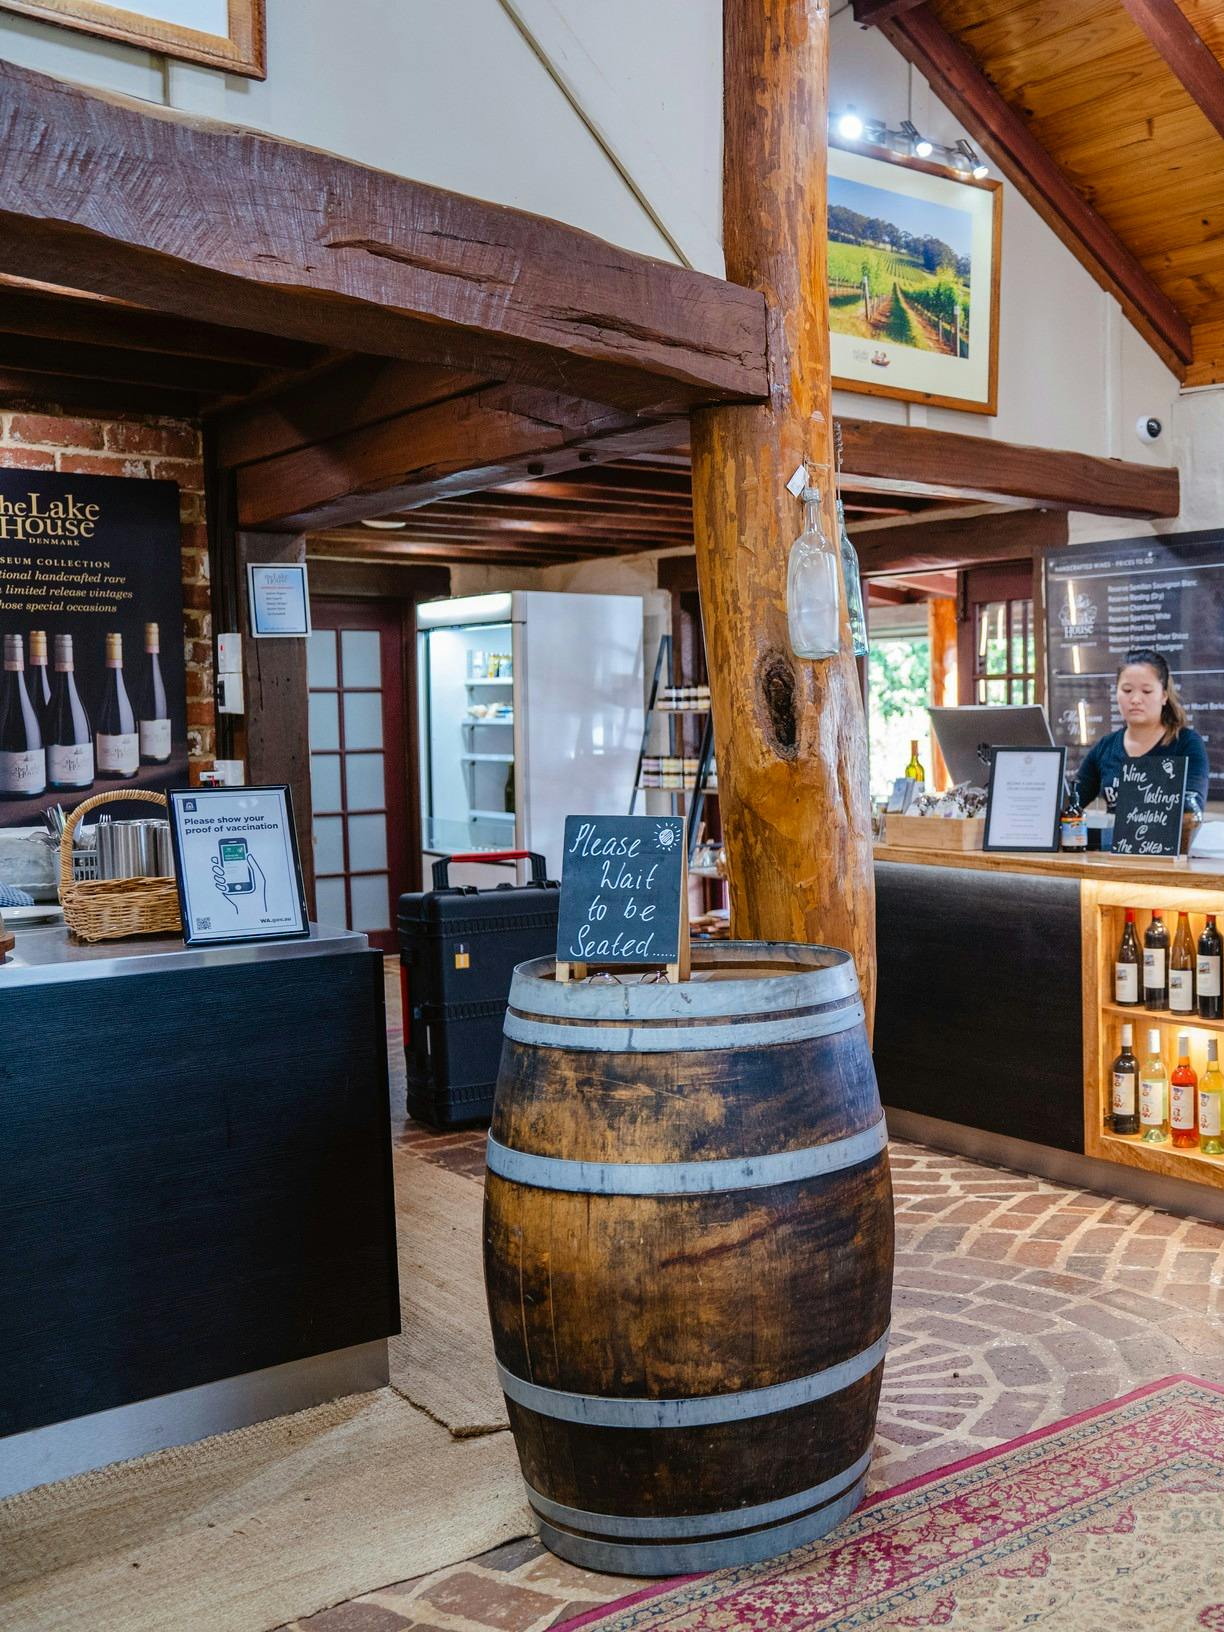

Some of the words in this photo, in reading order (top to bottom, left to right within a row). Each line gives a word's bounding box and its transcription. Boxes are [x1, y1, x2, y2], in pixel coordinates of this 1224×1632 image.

[0, 494, 27, 516] he
[27, 492, 100, 520] Lake
[0, 516, 95, 538] House
[28, 537, 80, 546] DENMARK
[0, 556, 31, 565] SEUM
[37, 558, 111, 569] COLLECTION
[0, 569, 32, 580] tional
[34, 571, 101, 584] handcrafted
[103, 576, 126, 584] rare
[5, 584, 46, 596] limited
[49, 587, 87, 598] release
[89, 587, 133, 600] vintages
[26, 600, 64, 612] special
[66, 603, 118, 613] occasions
[1122, 763, 1147, 782] Wine
[1137, 783, 1180, 811] Tastings
[184, 817, 215, 826] Please
[217, 816, 242, 824] show
[244, 814, 264, 825] your
[1126, 806, 1168, 826] Available
[185, 825, 212, 835] proof
[213, 823, 224, 833] of
[226, 822, 279, 832] vaccination
[569, 823, 641, 857] Please
[601, 860, 659, 890] Wait
[588, 895, 607, 921] to
[624, 897, 656, 921] be
